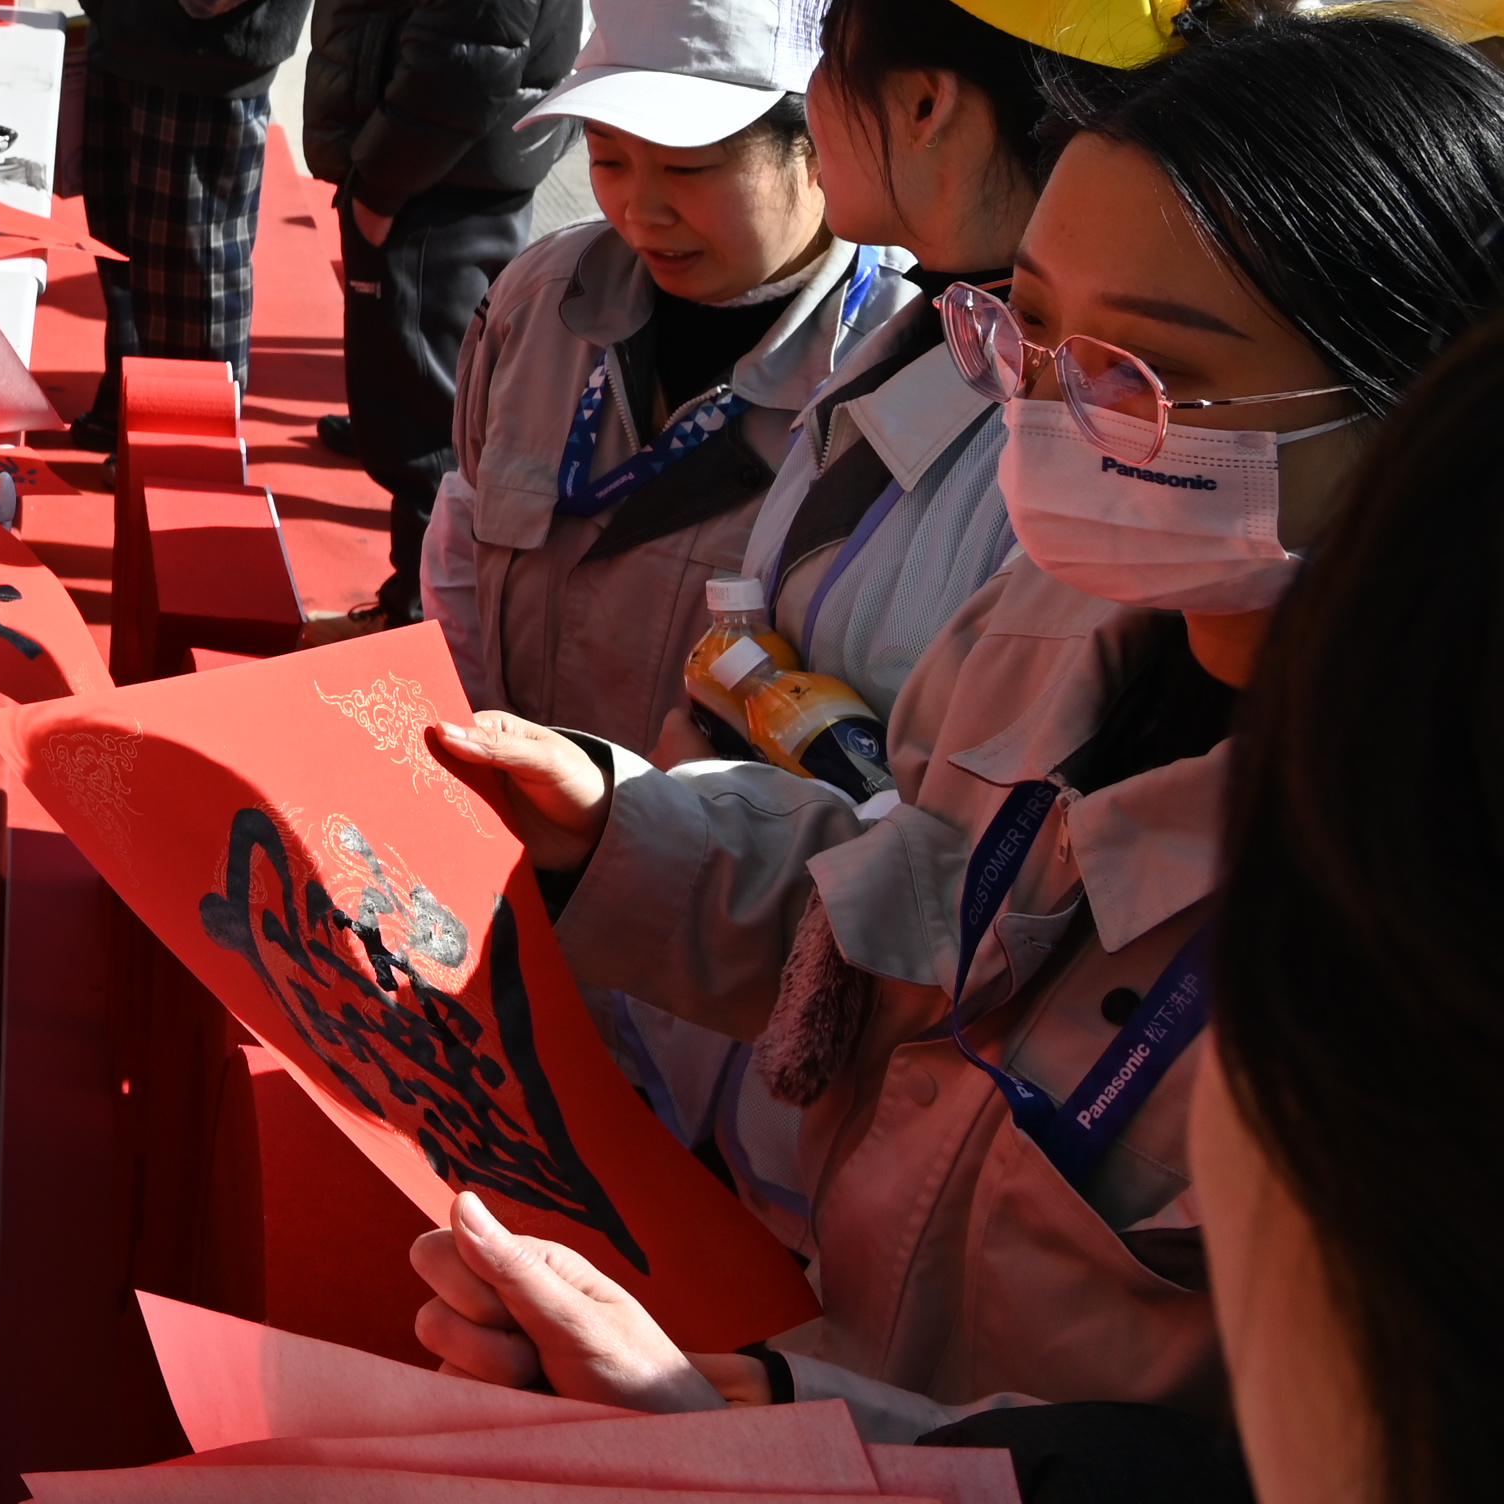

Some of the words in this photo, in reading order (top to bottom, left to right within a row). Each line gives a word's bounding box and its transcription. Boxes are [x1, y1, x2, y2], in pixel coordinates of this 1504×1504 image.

[1101, 455, 1218, 492] Panasonic
[968, 828, 1026, 925] CUSTOMER
[1016, 785, 1054, 831] FIRS
[1076, 1043, 1150, 1129] Panasonic
[1143, 973, 1198, 1043] 松下洗护
